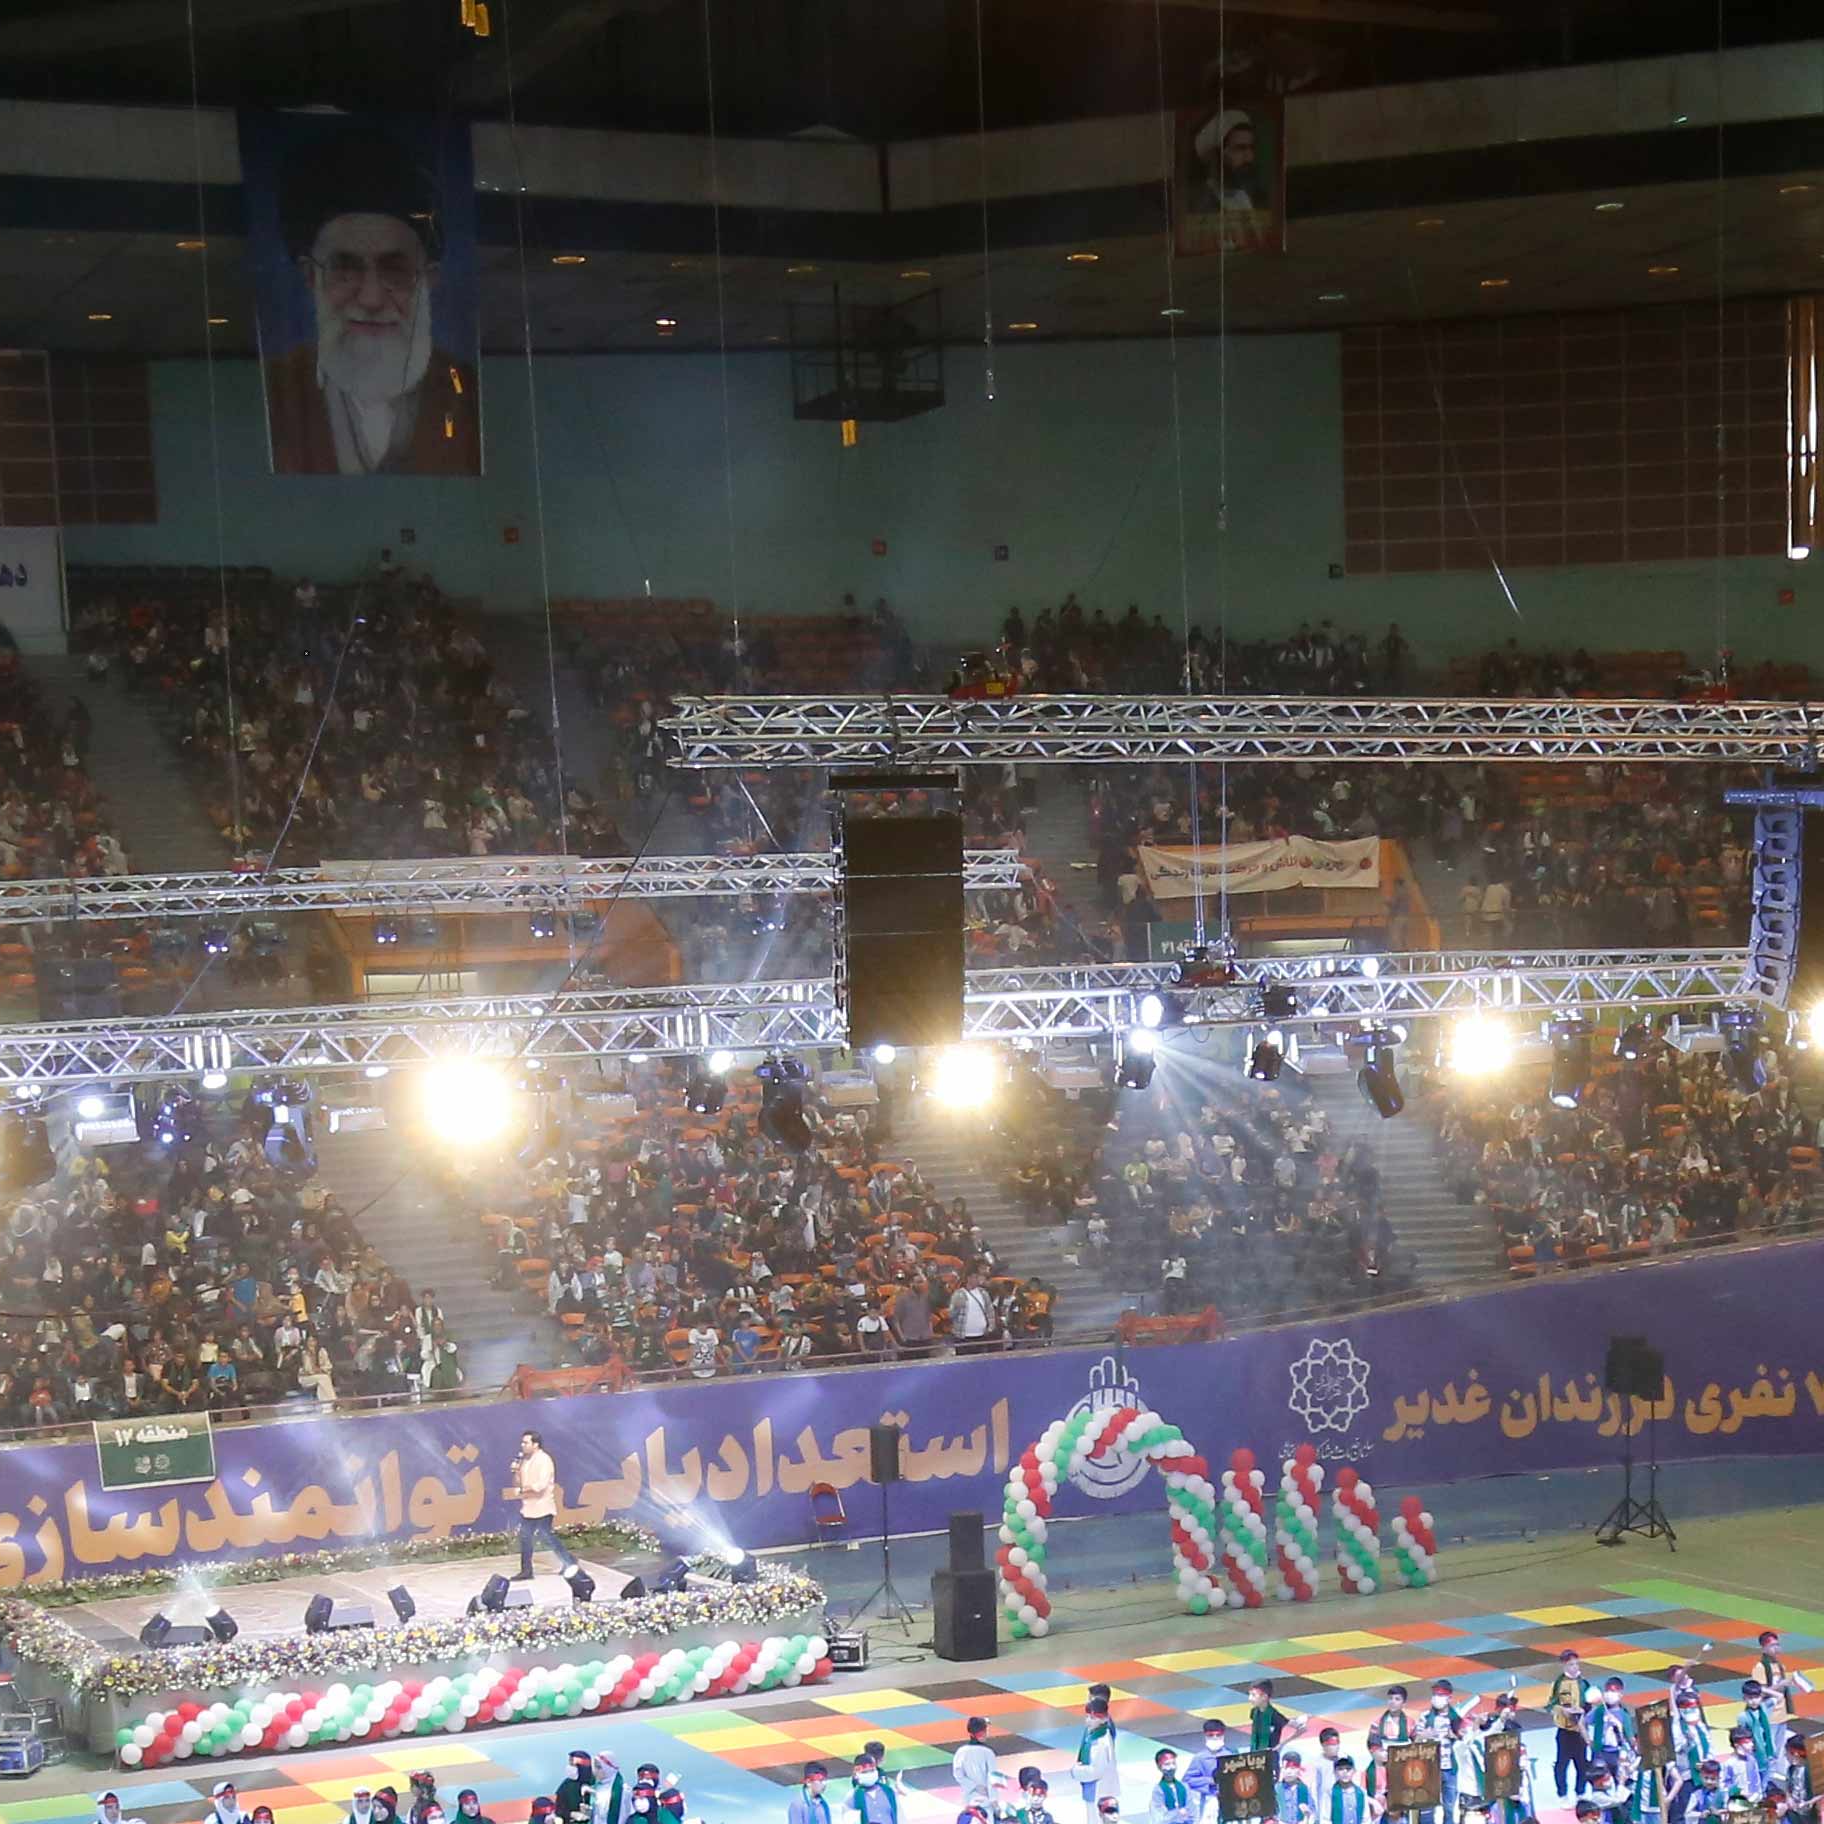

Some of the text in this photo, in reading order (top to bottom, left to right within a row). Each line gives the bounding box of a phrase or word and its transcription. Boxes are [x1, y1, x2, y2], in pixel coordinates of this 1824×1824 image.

[1382, 1367, 1492, 1443] غدیر
[1684, 1362, 1798, 1435] نفری
[135, 1423, 189, 1444] منطقه
[1221, 1754, 1267, 1774] پویا شهر
